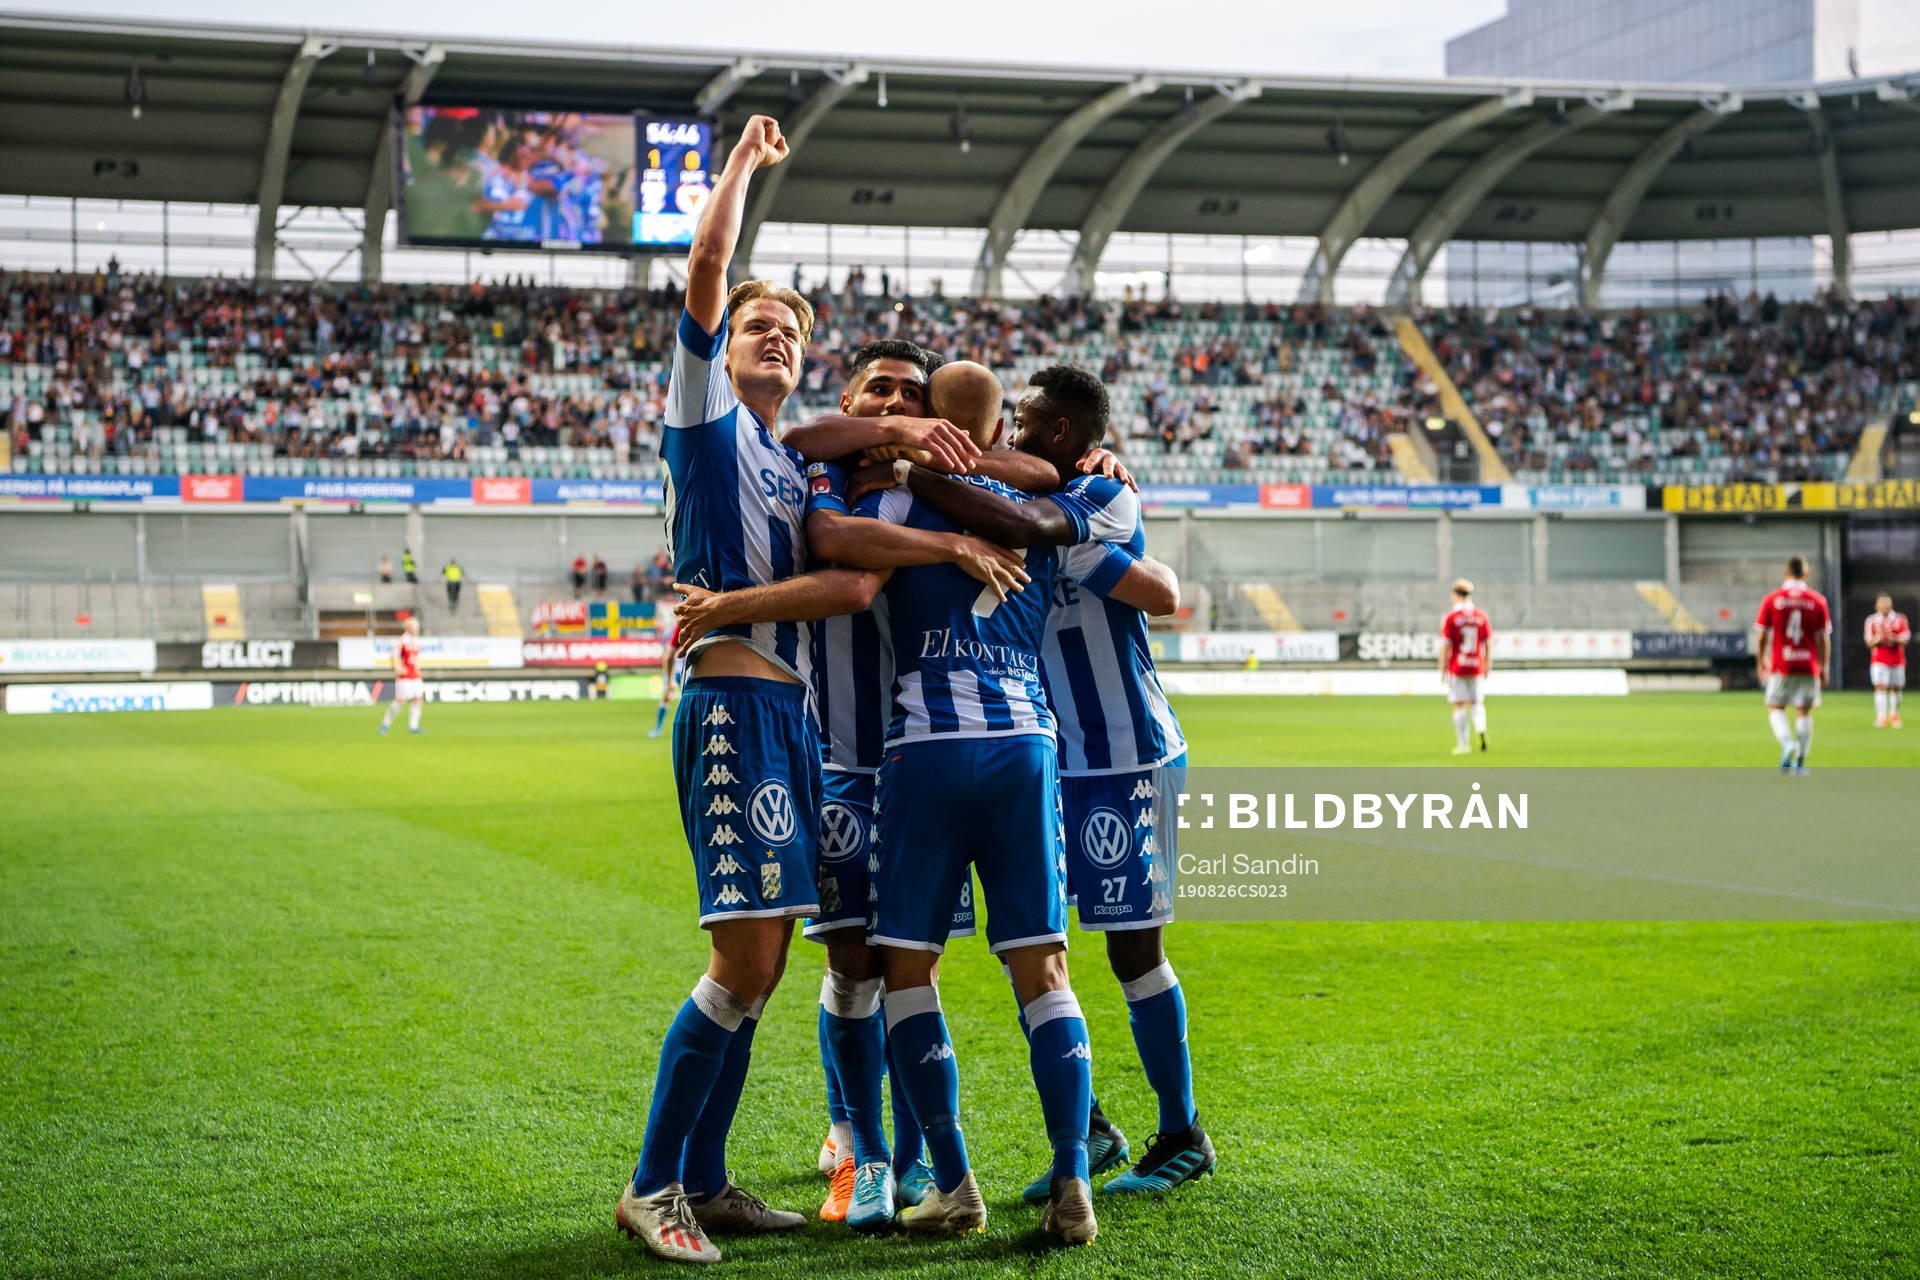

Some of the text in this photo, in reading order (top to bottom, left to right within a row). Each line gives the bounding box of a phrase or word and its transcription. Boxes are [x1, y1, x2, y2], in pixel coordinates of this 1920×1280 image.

[202, 640, 294, 668] SELECT
[920, 627, 951, 659] El
[1101, 876, 1127, 903] 27
[1094, 904, 1133, 916] Kappa
